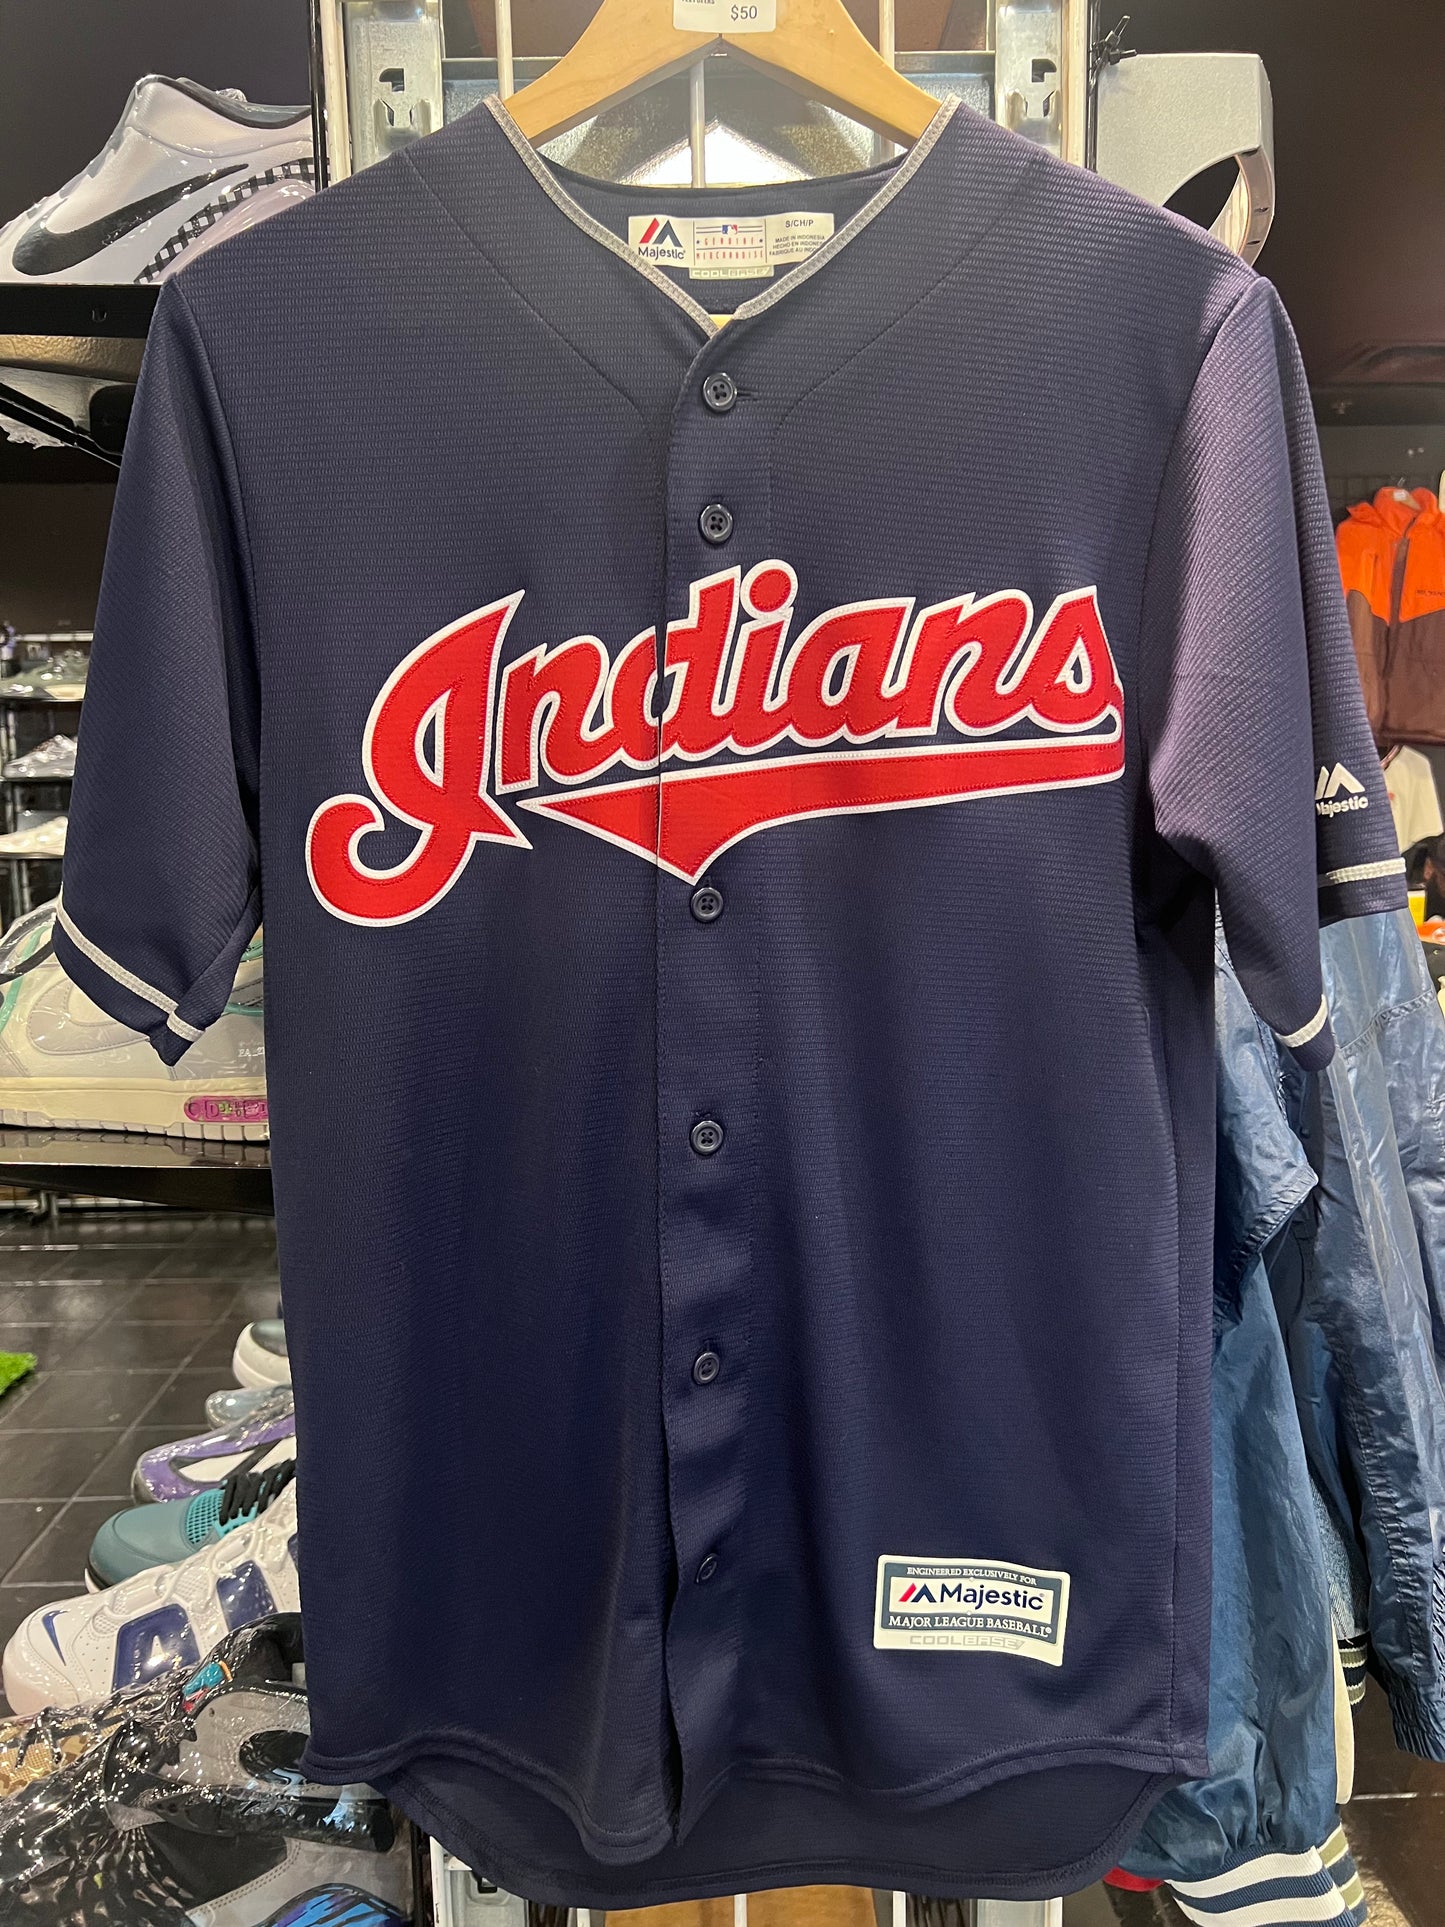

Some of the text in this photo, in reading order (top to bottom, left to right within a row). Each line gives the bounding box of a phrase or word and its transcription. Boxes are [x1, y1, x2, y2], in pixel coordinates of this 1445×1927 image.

[730, 4, 758, 21] $50
[785, 219, 814, 228] S/CH/P
[638, 246, 685, 260] Majestic
[305, 558, 1124, 928] Indians
[906, 1566, 1037, 1586] ENGINEERED EXCLUSIVELY FOR
[940, 1582, 1044, 1611] Majestic
[888, 1615, 932, 1629] MAJOR
[934, 1615, 984, 1628] LEAGUE
